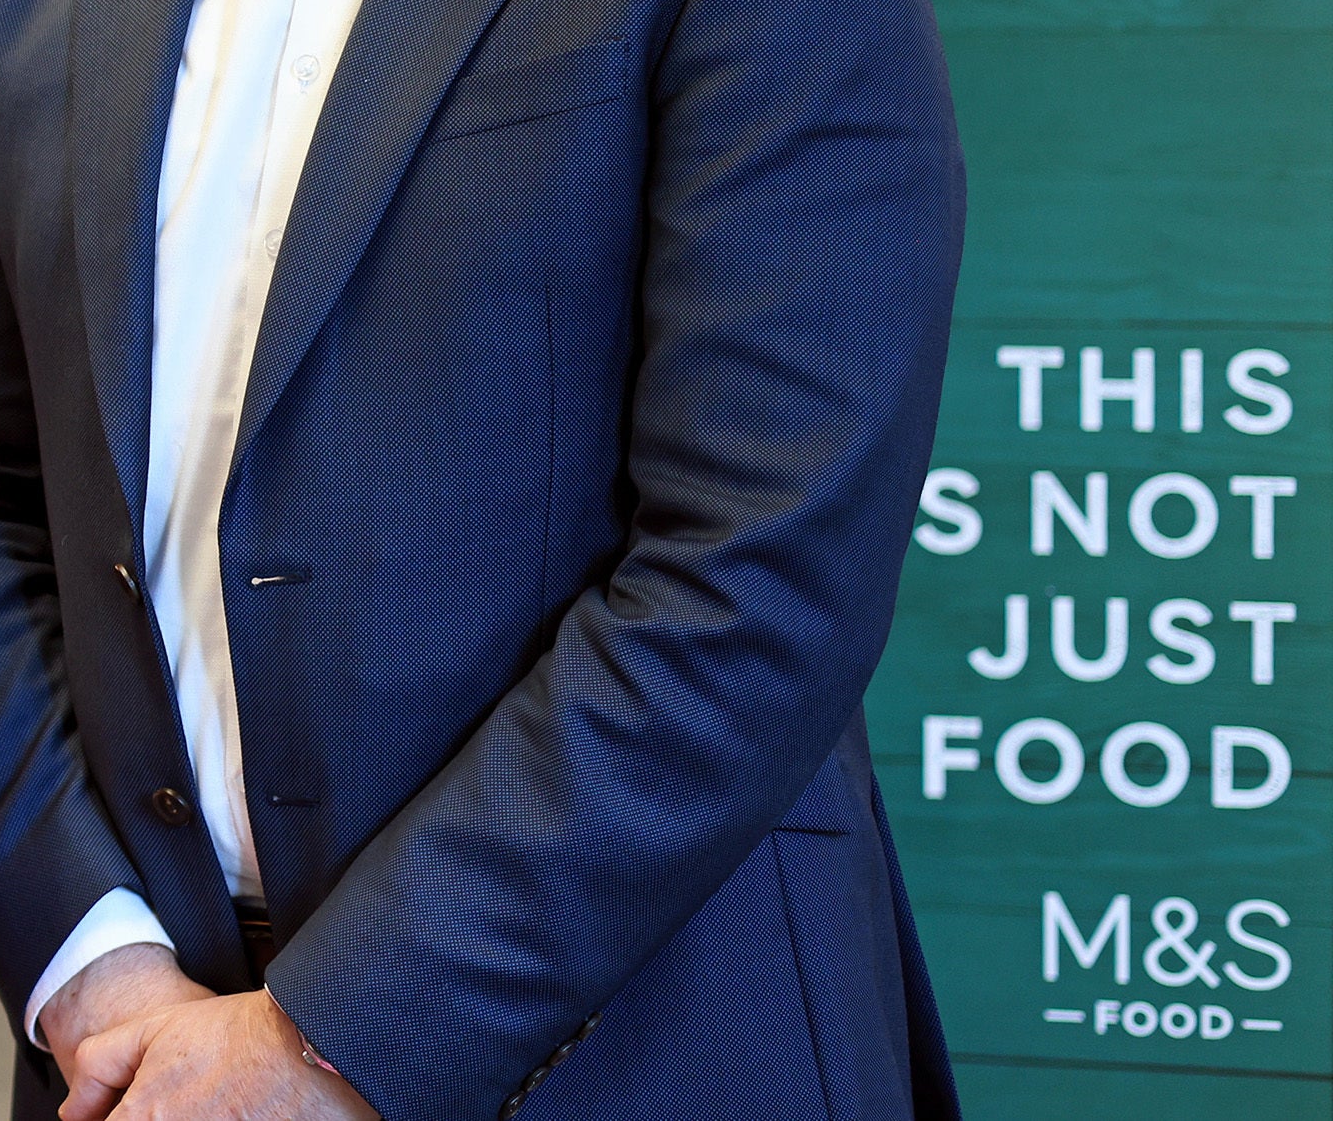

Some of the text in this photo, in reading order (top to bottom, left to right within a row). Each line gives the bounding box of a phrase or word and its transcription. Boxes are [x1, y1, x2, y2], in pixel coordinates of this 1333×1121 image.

[996, 345, 1293, 436] THIS
[913, 466, 1297, 561] S NOT
[966, 593, 1297, 686] JUST
[921, 714, 1293, 809] FOOD
[1041, 890, 1292, 992] M&S
[1094, 999, 1234, 1041] FOOD
